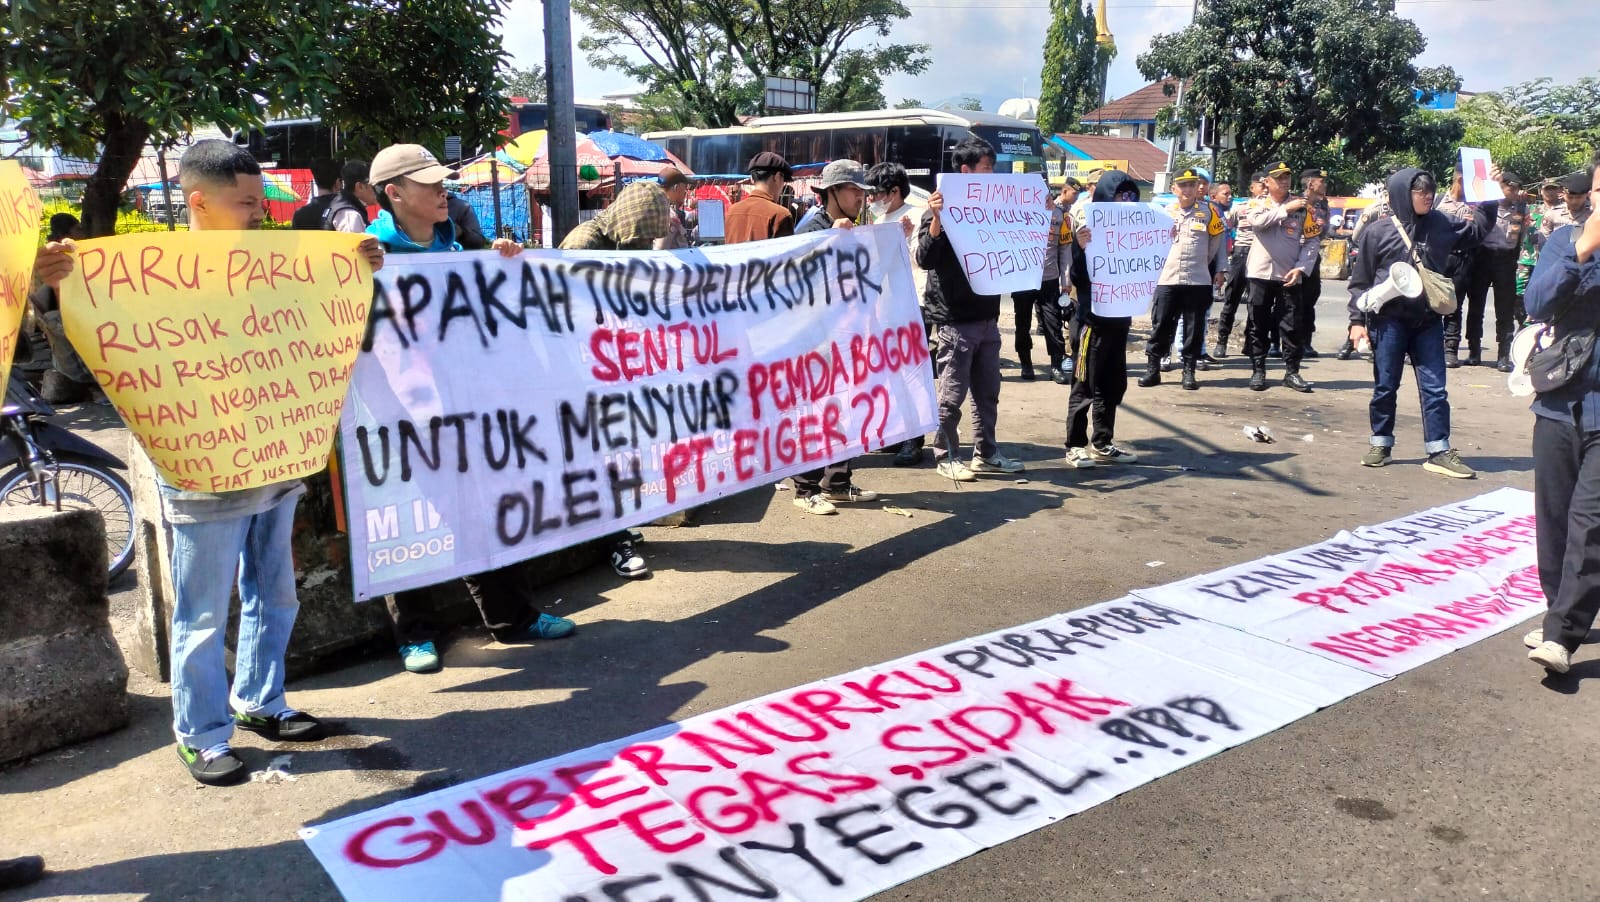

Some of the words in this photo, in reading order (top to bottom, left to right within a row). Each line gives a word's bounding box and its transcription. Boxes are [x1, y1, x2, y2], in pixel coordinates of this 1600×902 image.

[967, 183, 1043, 205] GIMMICK
[949, 206, 992, 226] DEDI
[994, 208, 1050, 226] MULYADI
[1092, 209, 1156, 228] PULIHKAN
[977, 229, 996, 244] DI
[1092, 255, 1152, 277] PUNCAK
[361, 258, 574, 352] APAKAH
[590, 320, 738, 383] SENTUL
[255, 415, 274, 434] DI
[356, 409, 548, 487] UNTUK
[262, 456, 317, 482] JUSTITIA
[496, 455, 643, 547] OLEH
[1196, 564, 1317, 602] IZIN
[342, 660, 962, 869] GUBERNURKU
[562, 755, 1106, 902] ENYEGEL
